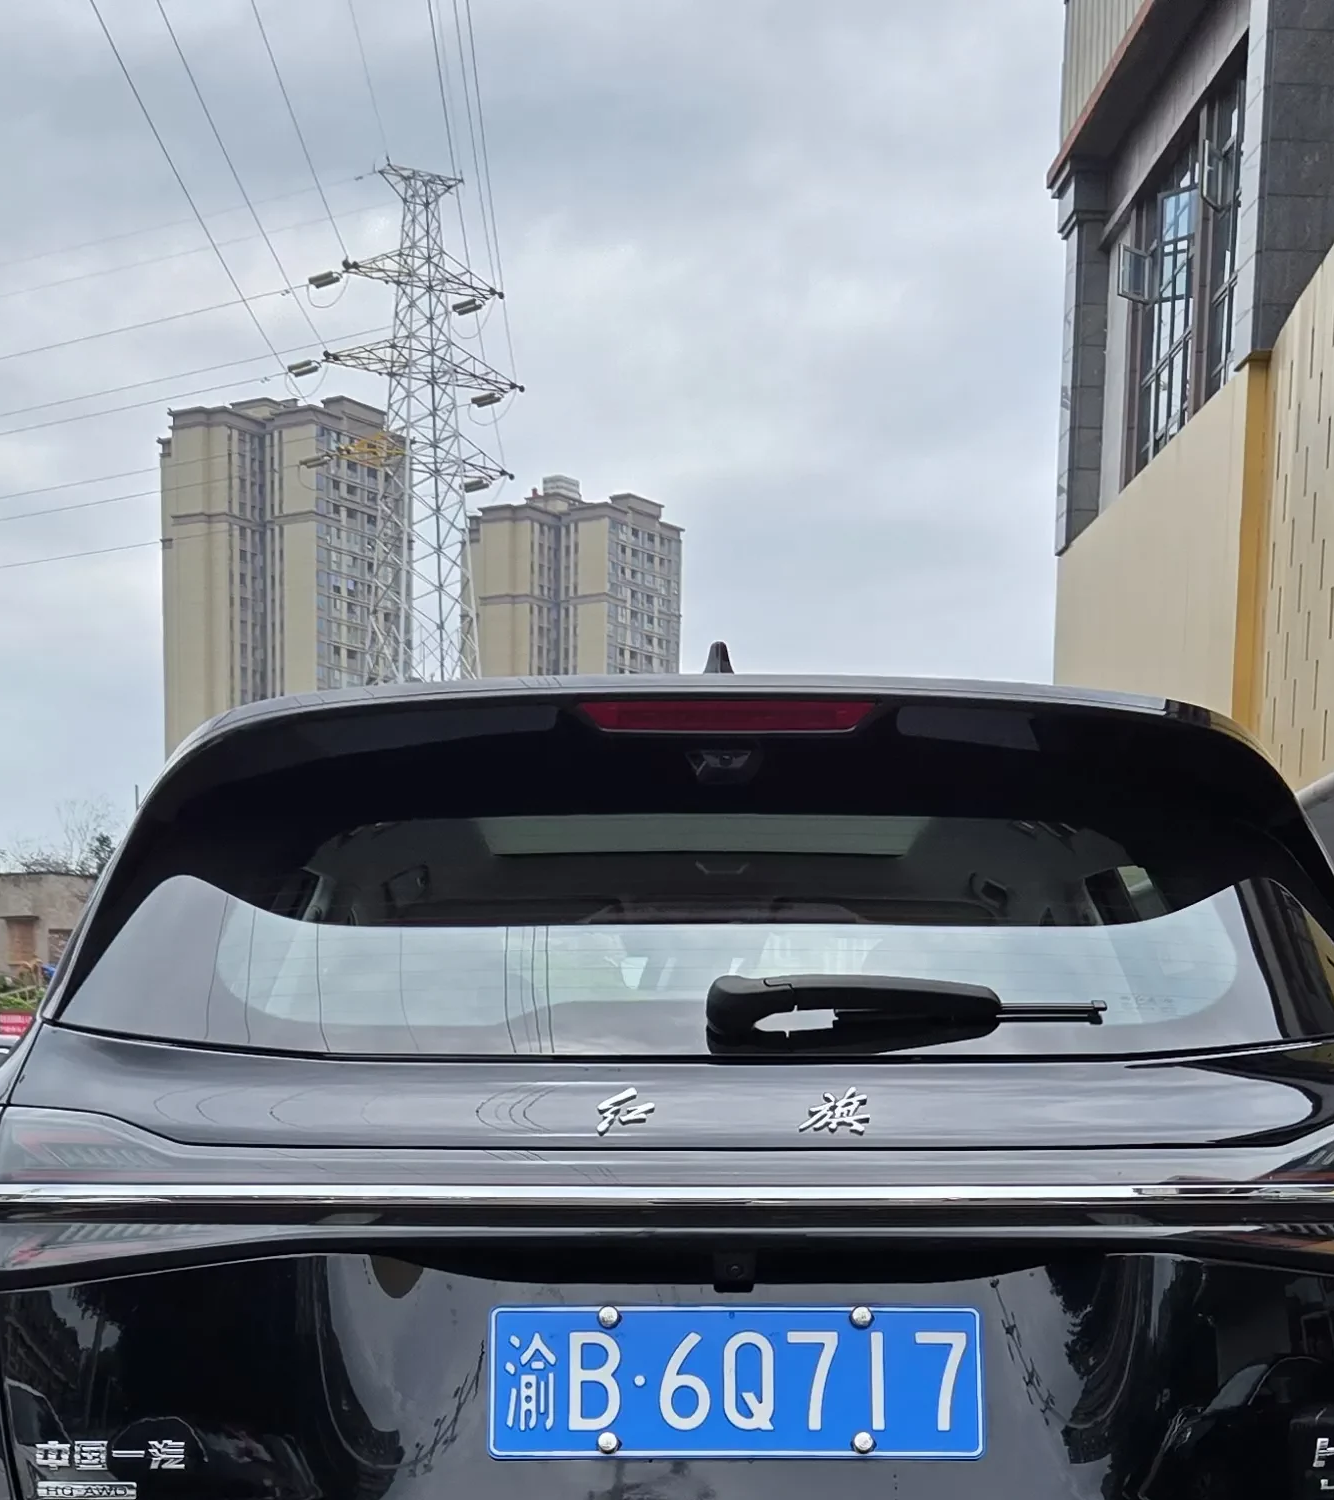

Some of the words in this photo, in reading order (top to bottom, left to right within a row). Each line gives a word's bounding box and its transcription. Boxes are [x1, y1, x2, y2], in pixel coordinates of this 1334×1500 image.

[596, 1086, 870, 1136] 红旗
[35, 1440, 186, 1471] 中国一汽
